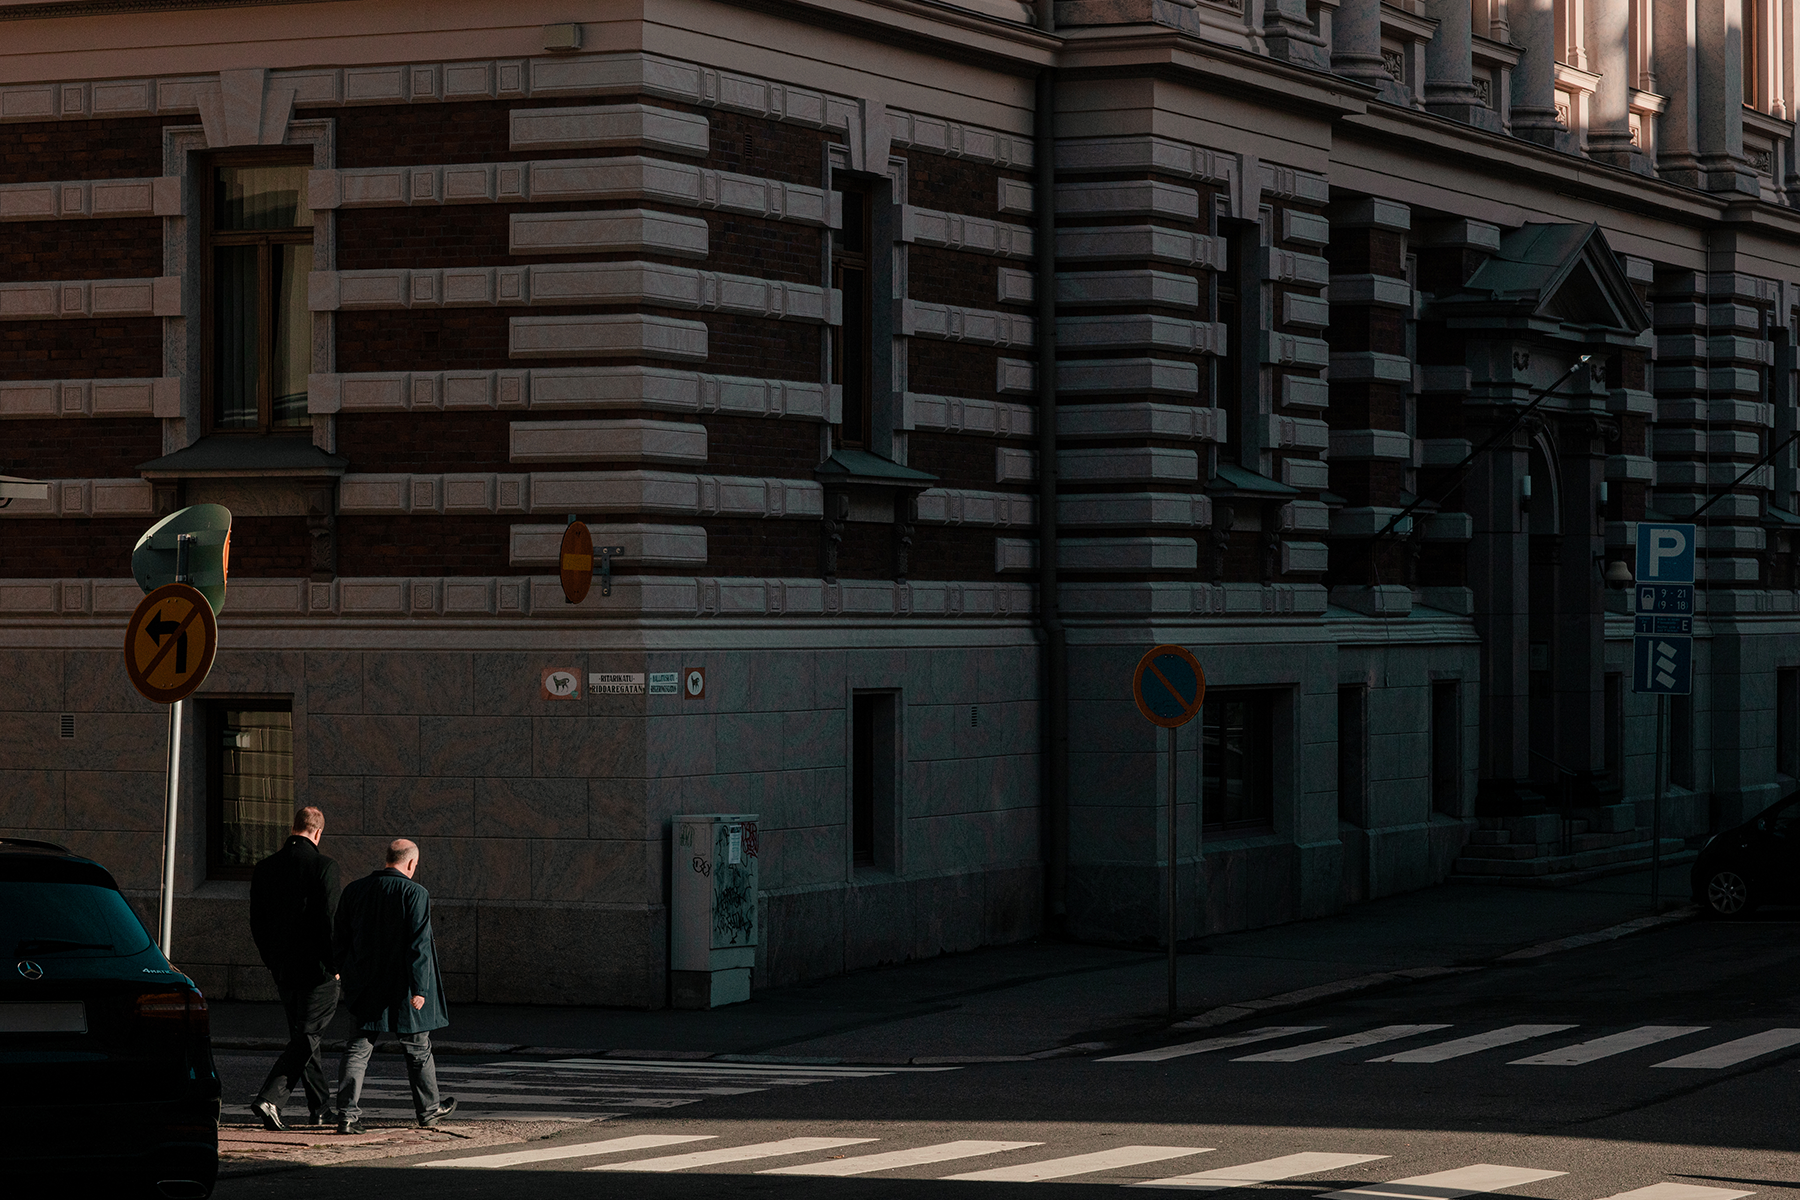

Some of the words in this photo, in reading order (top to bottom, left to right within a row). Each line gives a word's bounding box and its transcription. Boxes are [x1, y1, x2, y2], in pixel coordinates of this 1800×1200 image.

[1649, 529, 1686, 577] P
[1661, 589, 1667, 598] 9
[1677, 589, 1686, 598] 21
[1682, 620, 1688, 631] E
[592, 685, 643, 693] RIDDAREGATAN
